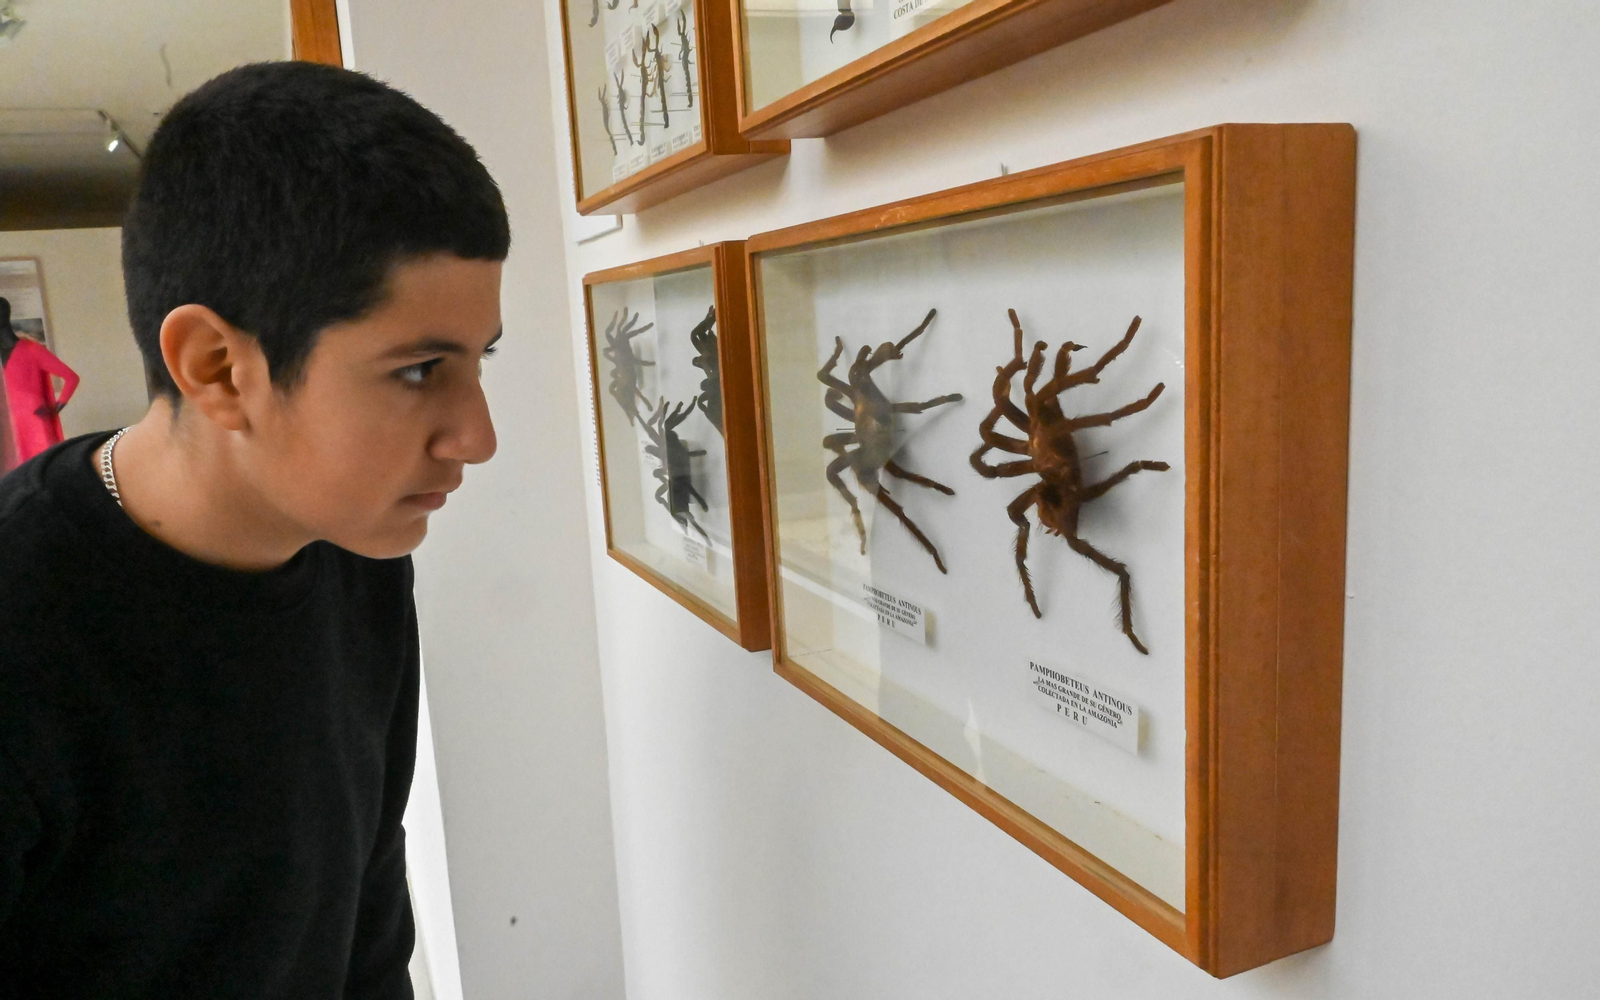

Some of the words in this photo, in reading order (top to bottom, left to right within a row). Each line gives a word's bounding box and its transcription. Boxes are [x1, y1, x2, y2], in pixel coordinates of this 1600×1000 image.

[1029, 661, 1090, 695] PAMPHOBETEUS
[1092, 689, 1133, 716] ANTINOUS
[1037, 684, 1070, 705] COLECTADA
[1070, 699, 1079, 708] EN
[1079, 704, 1087, 713] LA
[1045, 680, 1057, 690] MAS
[1057, 685, 1081, 700] GRANDE
[1081, 695, 1089, 705] DE
[1089, 699, 1097, 708] SU
